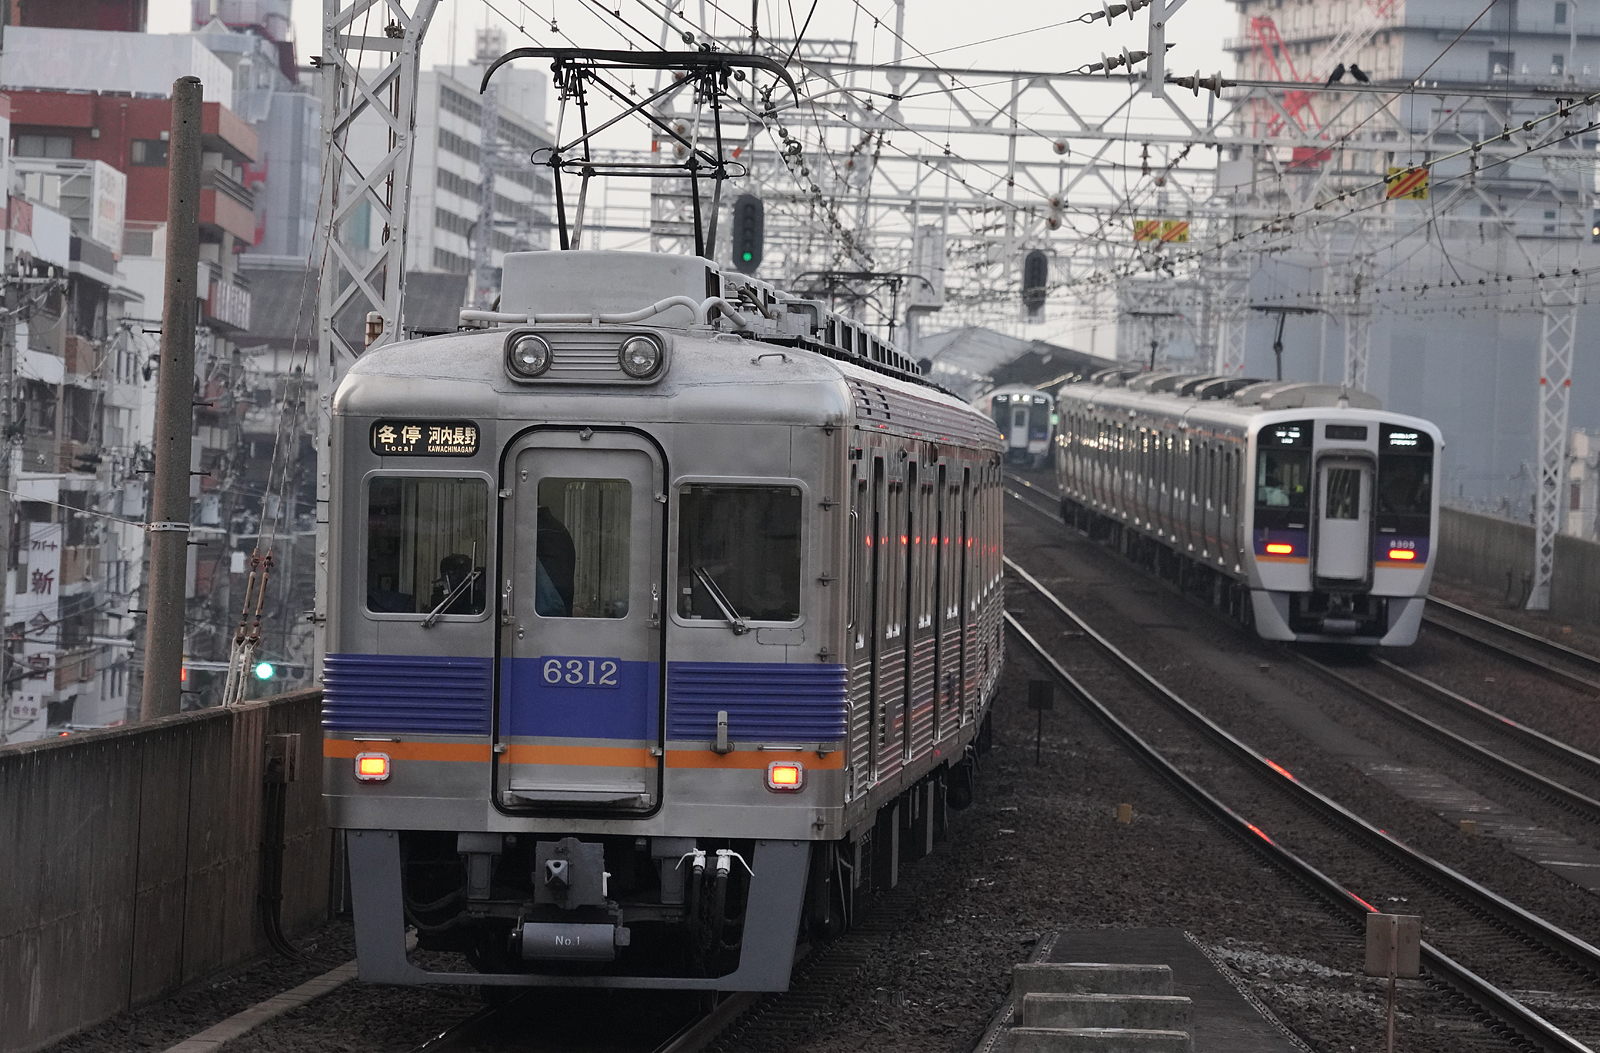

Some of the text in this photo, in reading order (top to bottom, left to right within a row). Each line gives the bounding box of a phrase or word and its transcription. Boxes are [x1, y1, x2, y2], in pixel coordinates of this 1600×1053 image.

[377, 425, 477, 445] 各停 河内長野
[385, 444, 414, 452] Local
[543, 659, 617, 686] 6312
[555, 935, 581, 946] No.1
